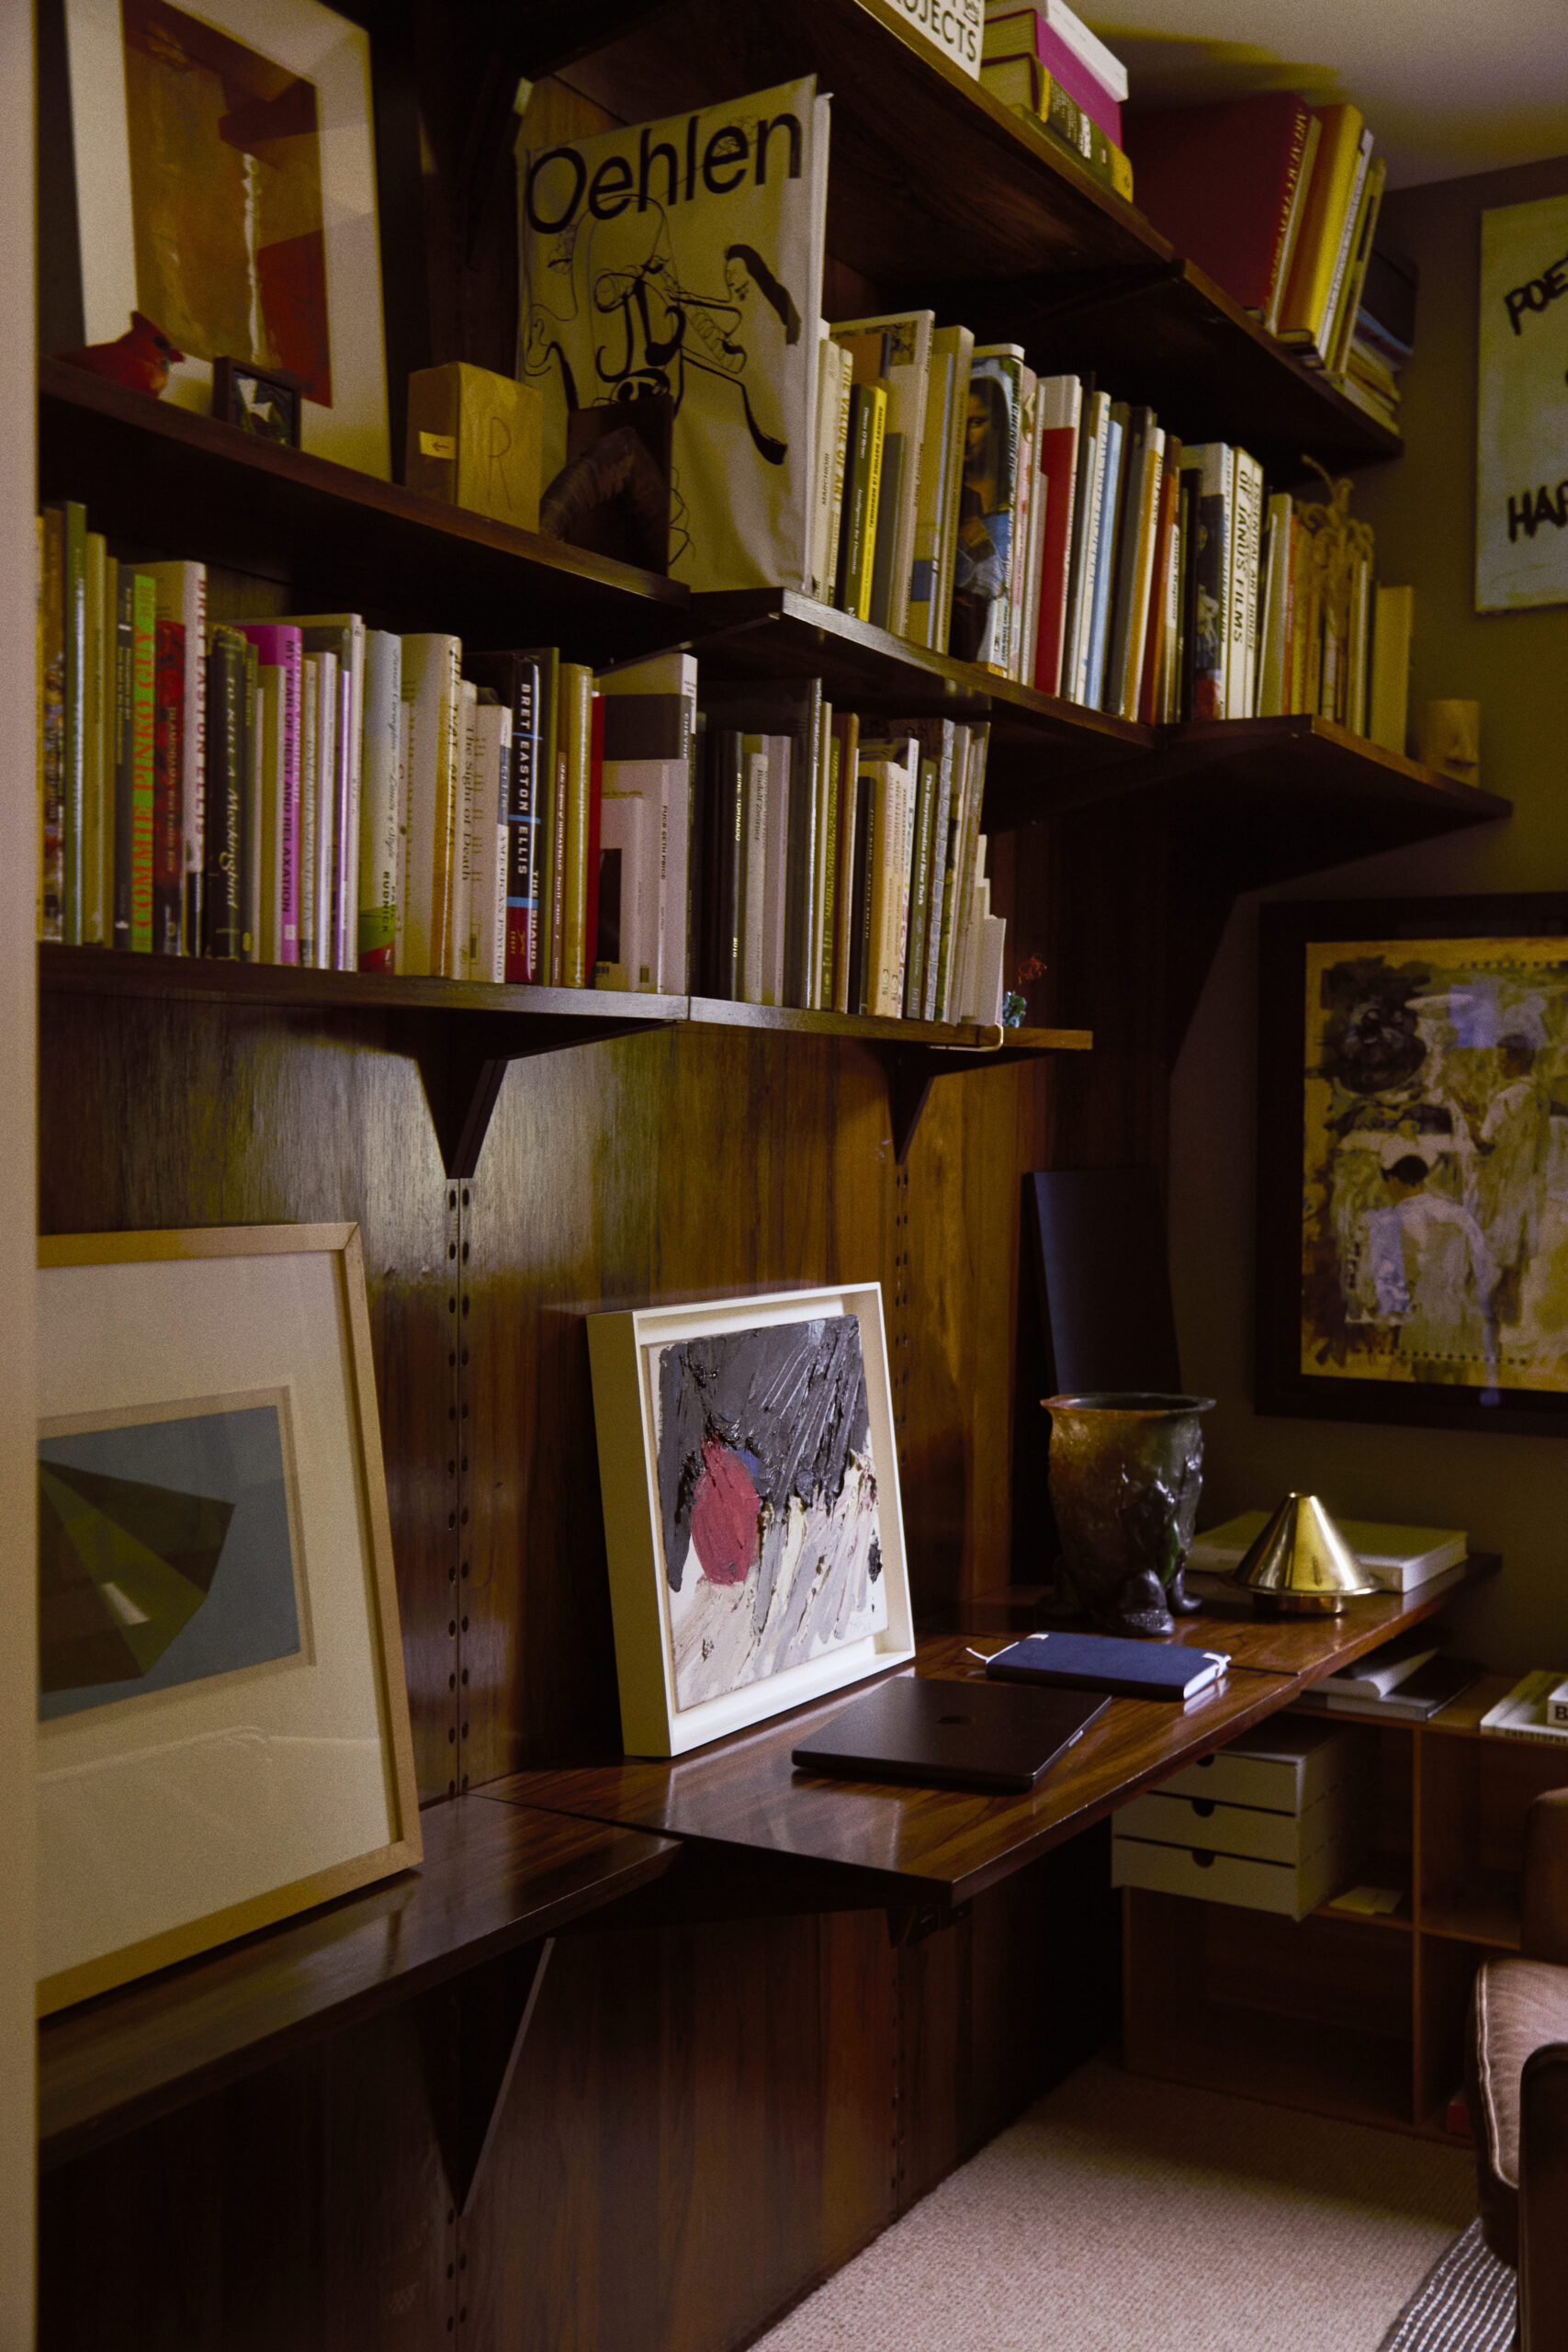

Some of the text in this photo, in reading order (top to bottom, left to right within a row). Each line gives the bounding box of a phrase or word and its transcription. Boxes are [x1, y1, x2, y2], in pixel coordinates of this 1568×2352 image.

[526, 113, 803, 234] Oehlen
[833, 364, 852, 504] THE VALUE OF ART
[1233, 470, 1249, 644] OF JANUS FILMS
[1247, 483, 1261, 651] ESSENTIAL ART HOUSE
[134, 627, 155, 690] GUY
[195, 580, 207, 837] BRET EASTON ELLIS
[133, 700, 154, 790] PINKO
[281, 640, 295, 913] MY YEAR OF REST AND RELAXATION
[517, 684, 531, 875] BRET EASTON ELLIS
[682, 712, 690, 760] CHEYNE
[925, 774, 933, 792] The
[132, 805, 152, 928] COMMIE
[220, 787, 240, 909] Mockingbird
[461, 729, 475, 882] The Sight of Death
[921, 792, 931, 852] Encyclopedia
[382, 871, 390, 933] RUDNICK
[496, 836, 508, 976] AMERICAN PSYCHO
[529, 870, 540, 970] THE SHARDS
